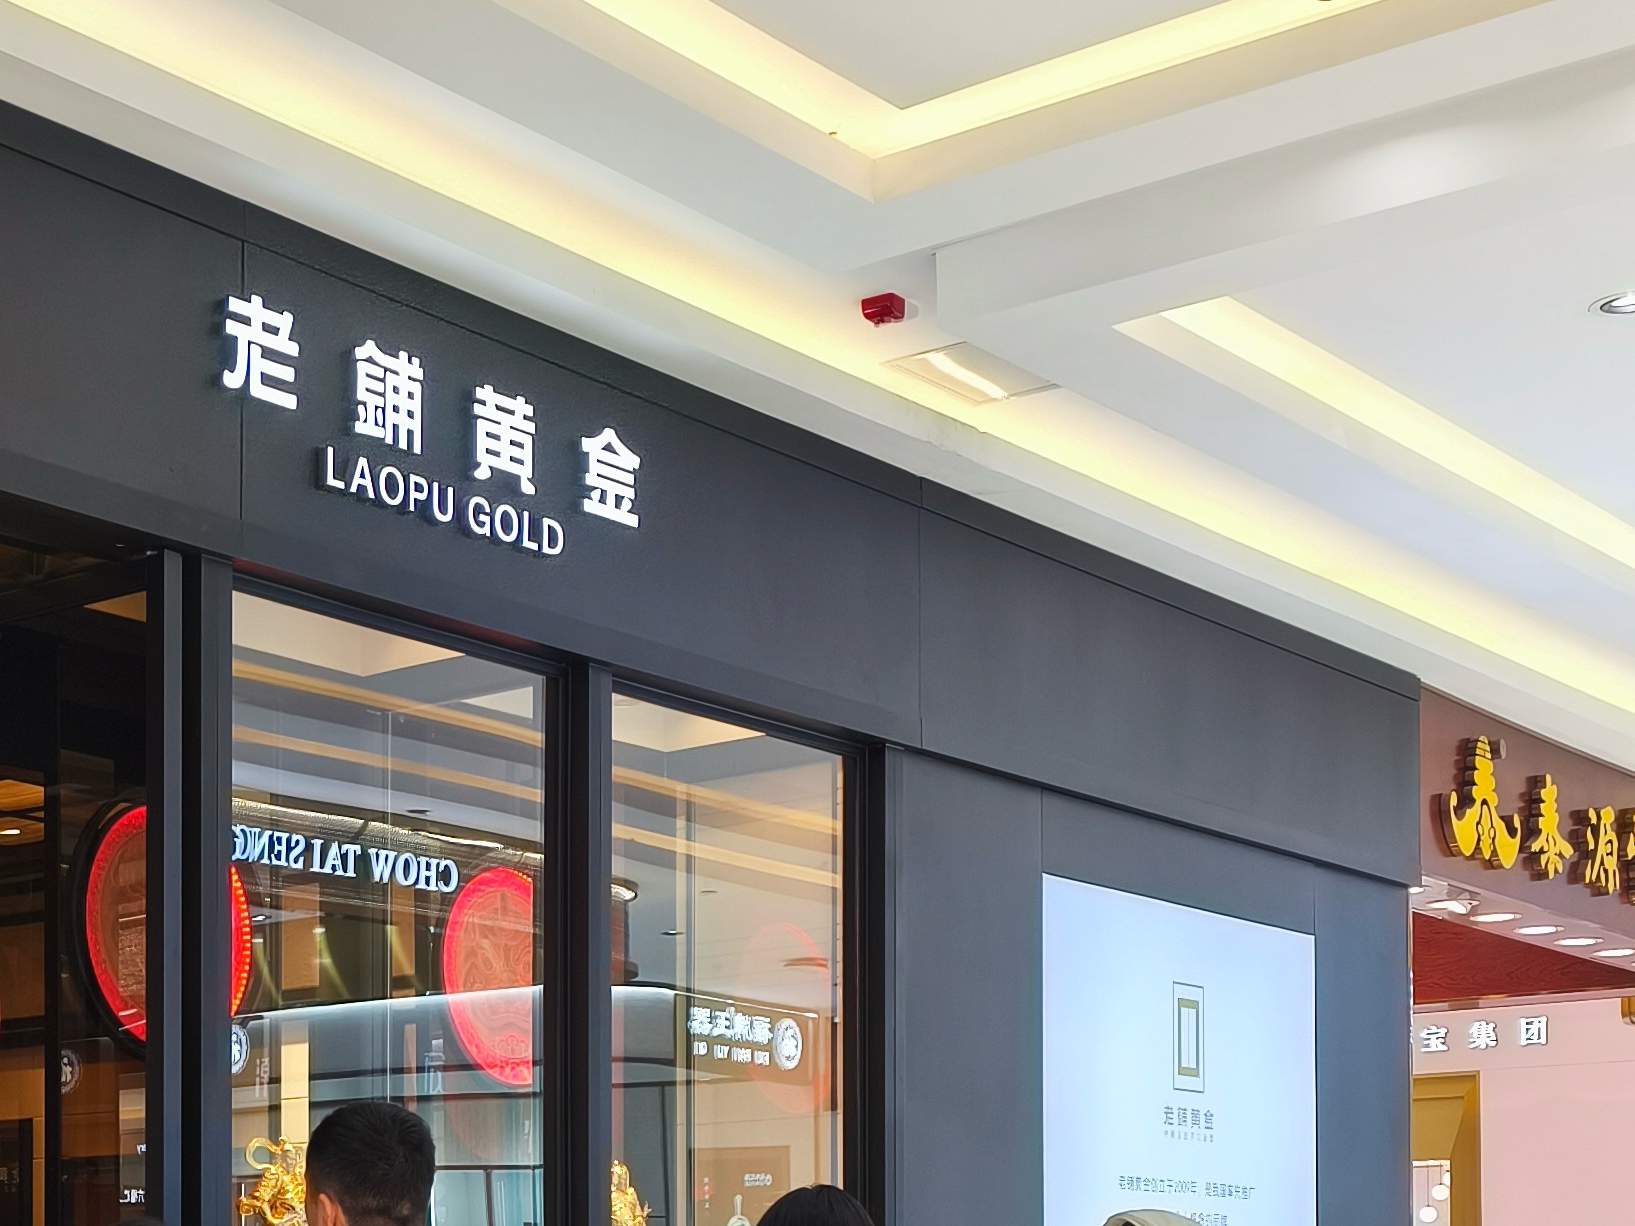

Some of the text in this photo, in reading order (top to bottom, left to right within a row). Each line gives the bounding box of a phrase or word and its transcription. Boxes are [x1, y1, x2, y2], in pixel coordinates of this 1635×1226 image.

[325, 446, 565, 556] LAOPU GOLD
[1420, 1015, 1549, 1053] 宝集团
